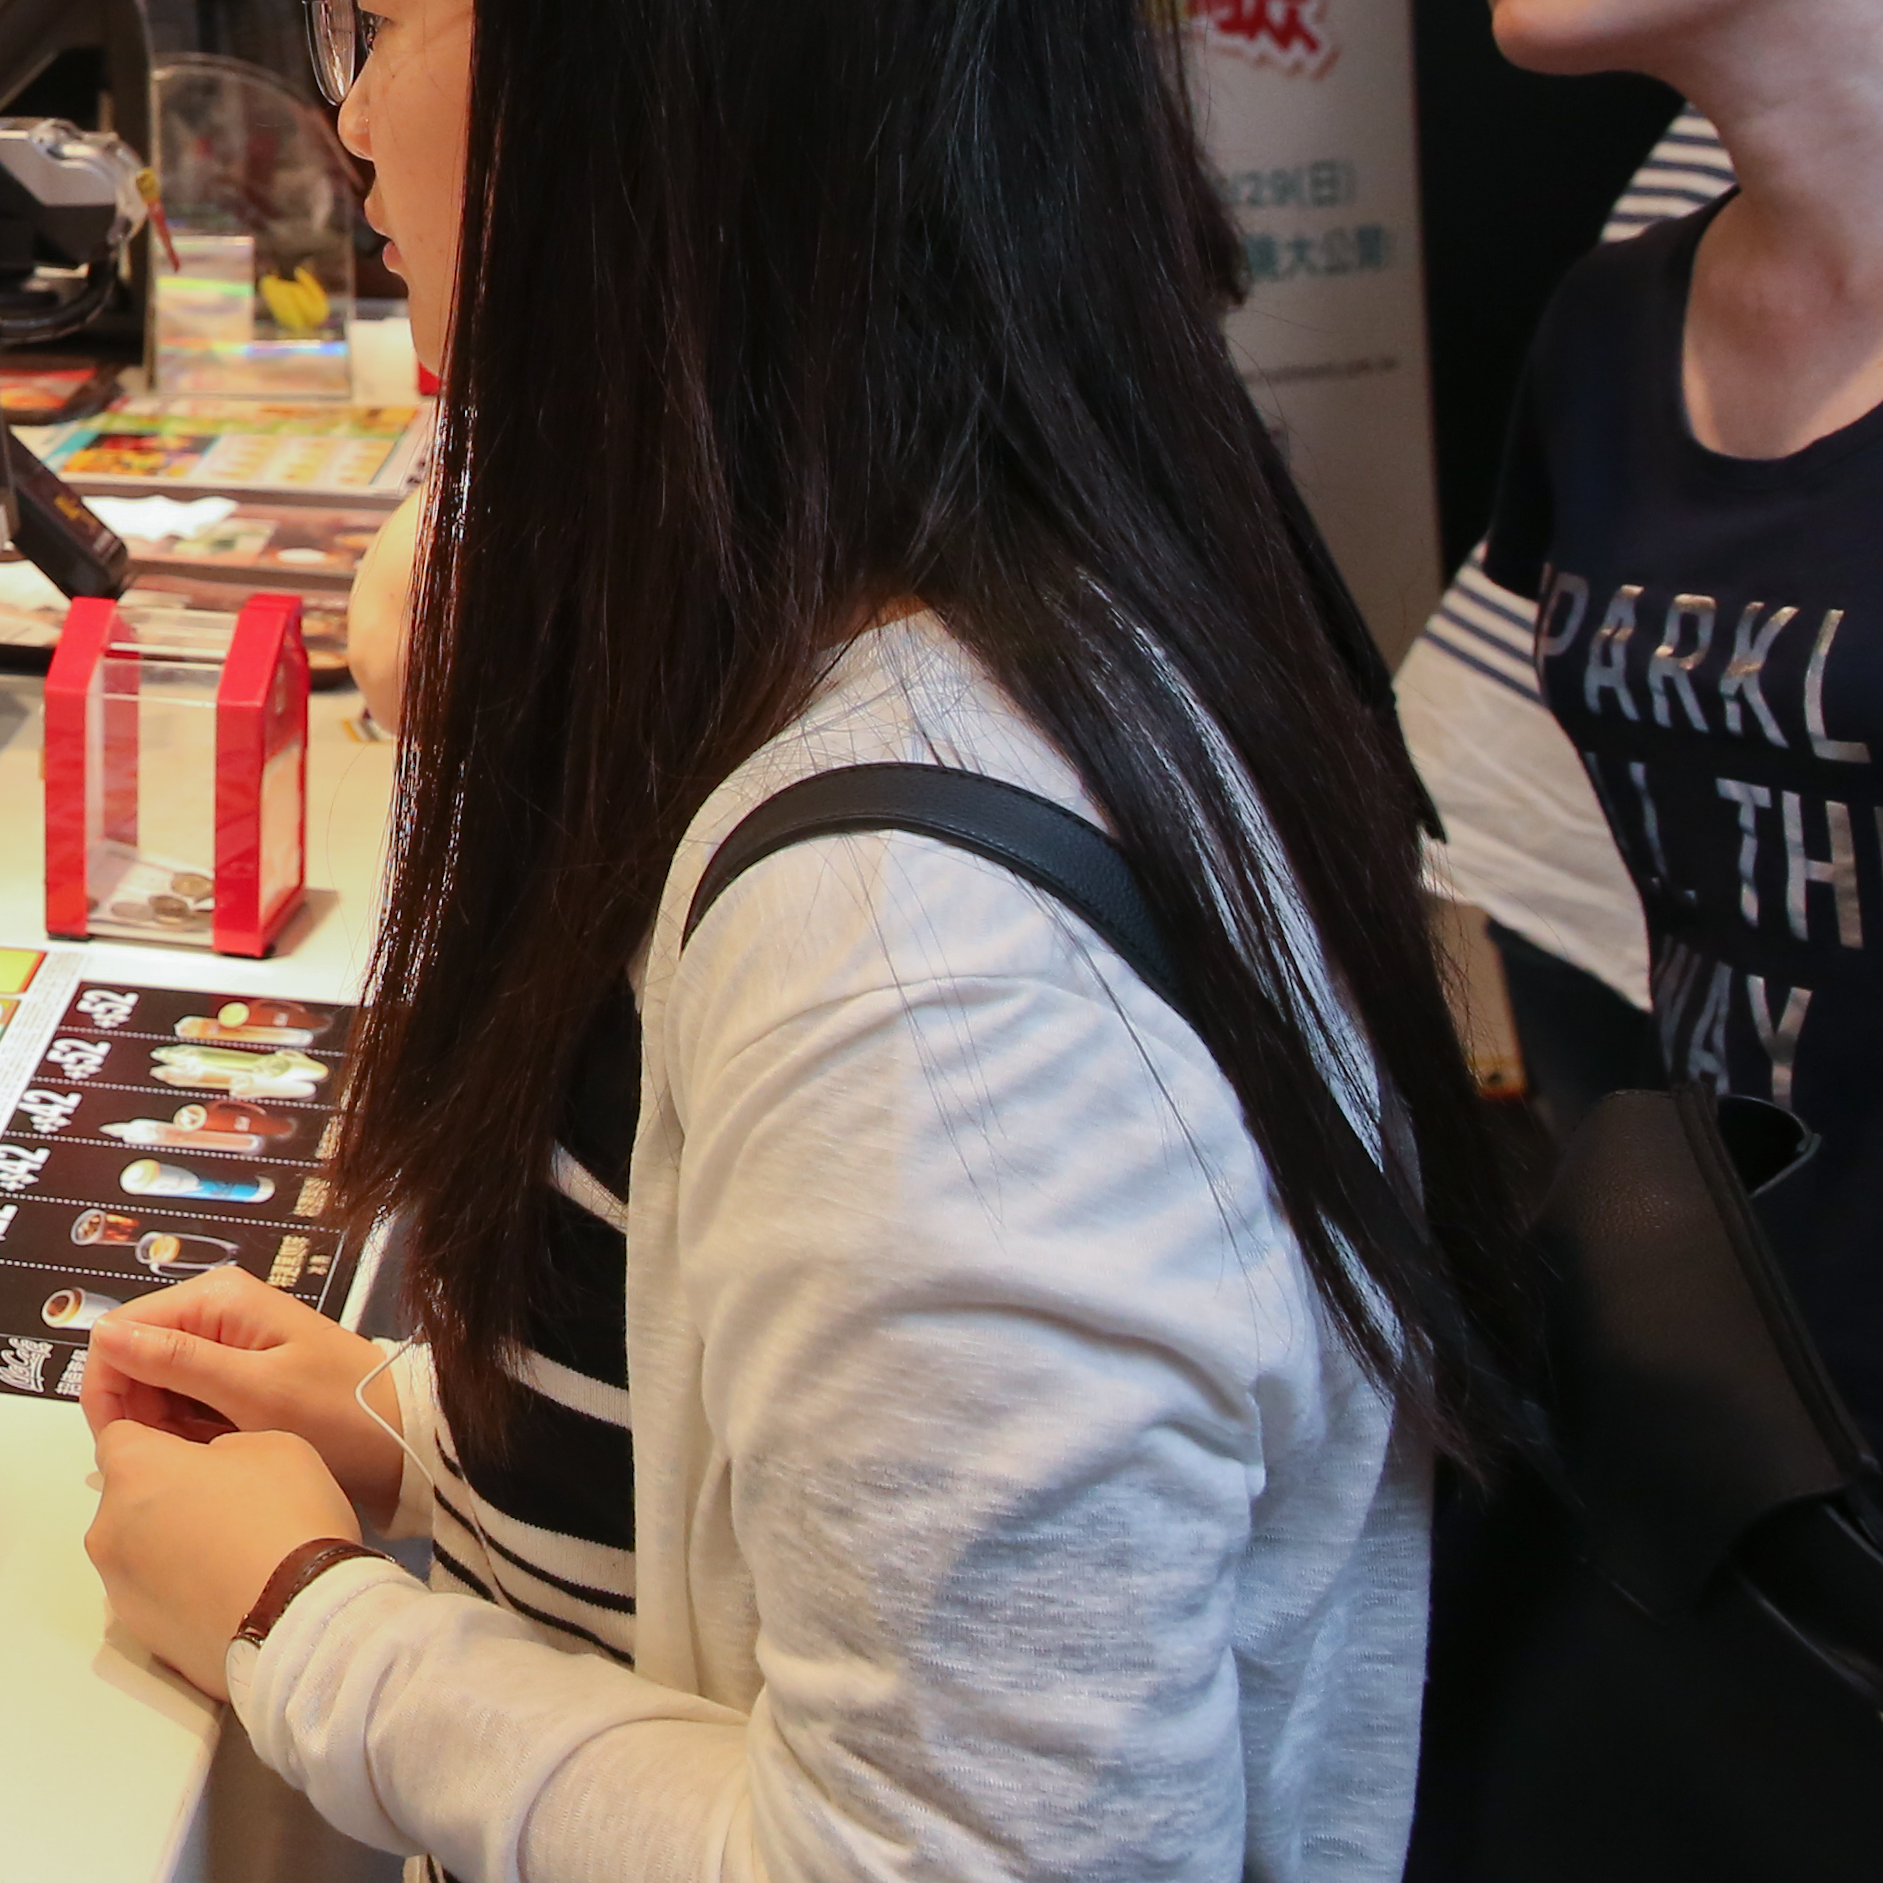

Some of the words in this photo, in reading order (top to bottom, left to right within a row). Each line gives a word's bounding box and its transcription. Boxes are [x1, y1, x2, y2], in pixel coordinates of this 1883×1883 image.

[1716, 776, 1883, 951] TH
[77, 988, 140, 1031] +$52
[46, 1036, 113, 1081] +$52
[17, 1087, 84, 1135] +$42
